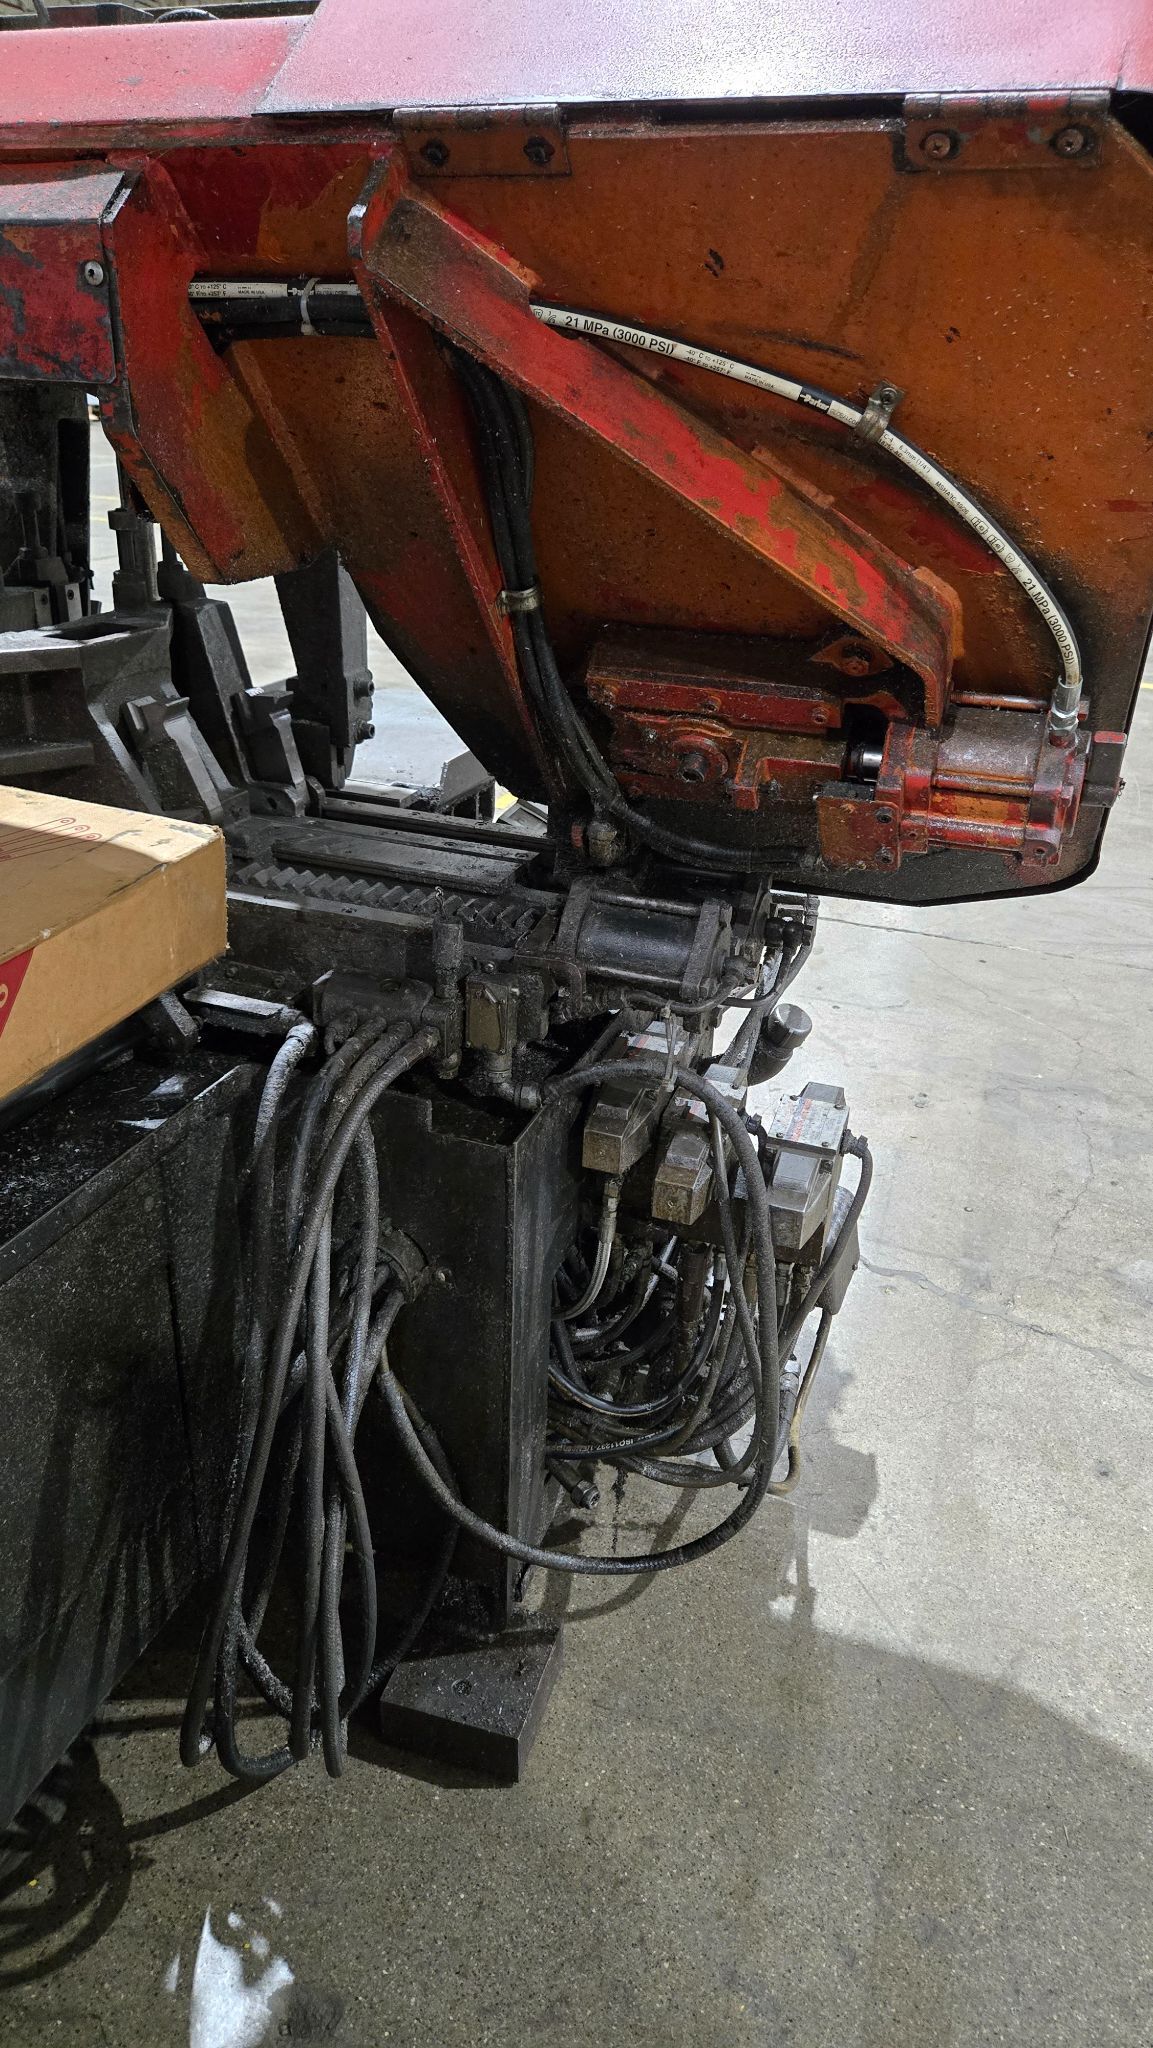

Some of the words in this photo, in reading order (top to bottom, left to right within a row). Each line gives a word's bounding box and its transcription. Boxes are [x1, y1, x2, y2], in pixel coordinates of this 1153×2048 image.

[565, 315, 579, 328] 21
[584, 319, 609, 336] MPa
[613, 327, 646, 346] (3000
[649, 338, 674, 355] PSI)
[802, 393, 830, 411] Parker
[1022, 578, 1036, 591] 21
[1032, 591, 1051, 615] MPa
[1046, 614, 1068, 643] (3000
[1061, 643, 1075, 665] PSI)
